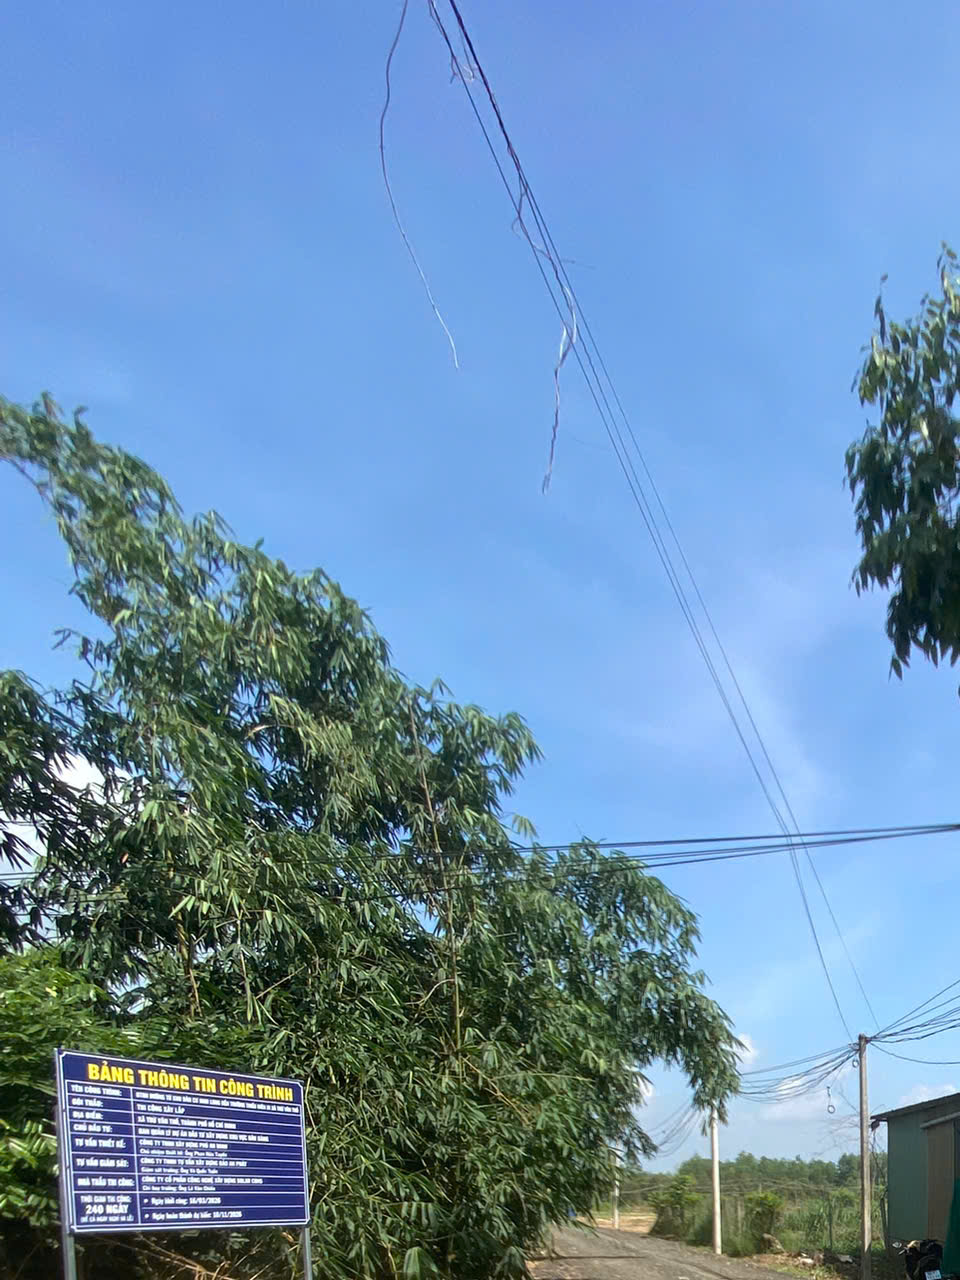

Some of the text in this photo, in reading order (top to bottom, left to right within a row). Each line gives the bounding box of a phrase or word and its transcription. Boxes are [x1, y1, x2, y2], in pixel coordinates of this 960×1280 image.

[87, 1060, 294, 1102] BẢNG THÔNG TIN CÔNG TRÌNH
[86, 1203, 128, 1215] 240 NGÀY
